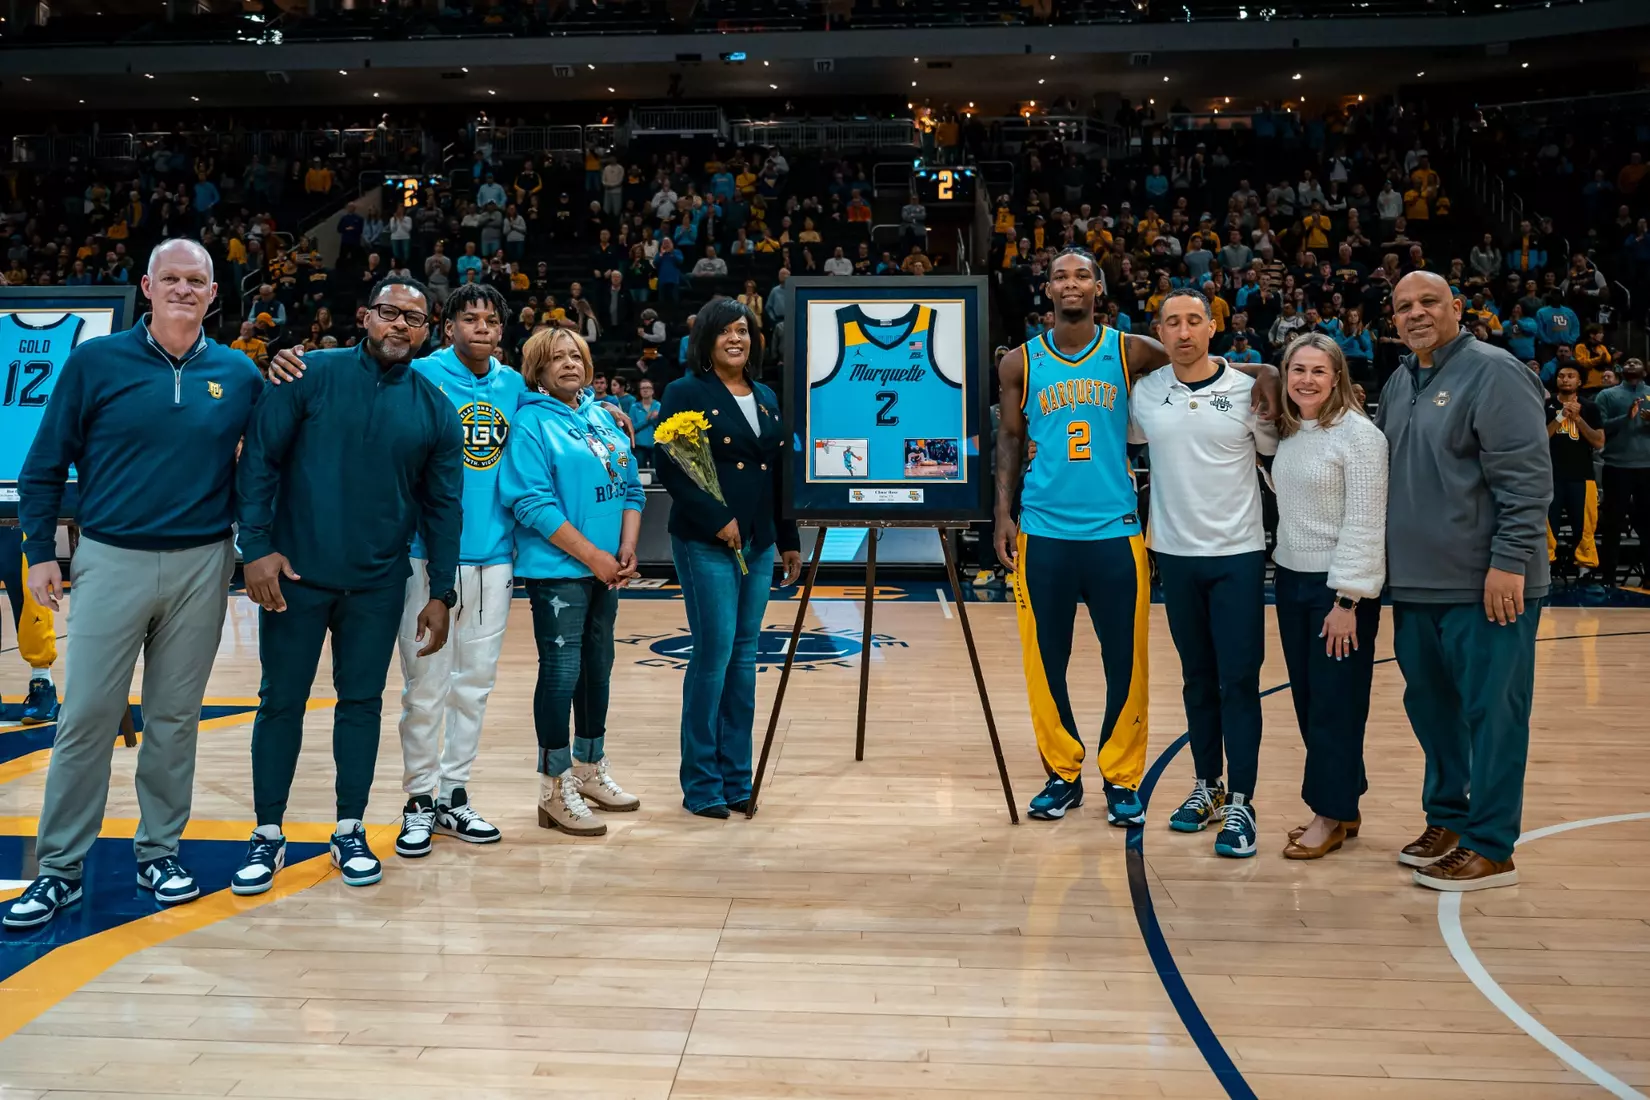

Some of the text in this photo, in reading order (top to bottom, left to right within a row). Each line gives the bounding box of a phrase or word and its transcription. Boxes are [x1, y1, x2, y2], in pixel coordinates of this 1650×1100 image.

[817, 61, 831, 72] 117
[404, 178, 418, 207] 2
[938, 170, 953, 199] 2
[1553, 315, 1567, 326] MU
[19, 339, 51, 353] GOLD
[2, 360, 53, 407] 12
[849, 364, 926, 386] Marquette
[875, 391, 899, 426] 2
[1037, 378, 1118, 416] MARQUETTE
[568, 424, 617, 440] CASE
[1067, 420, 1092, 462] 2
